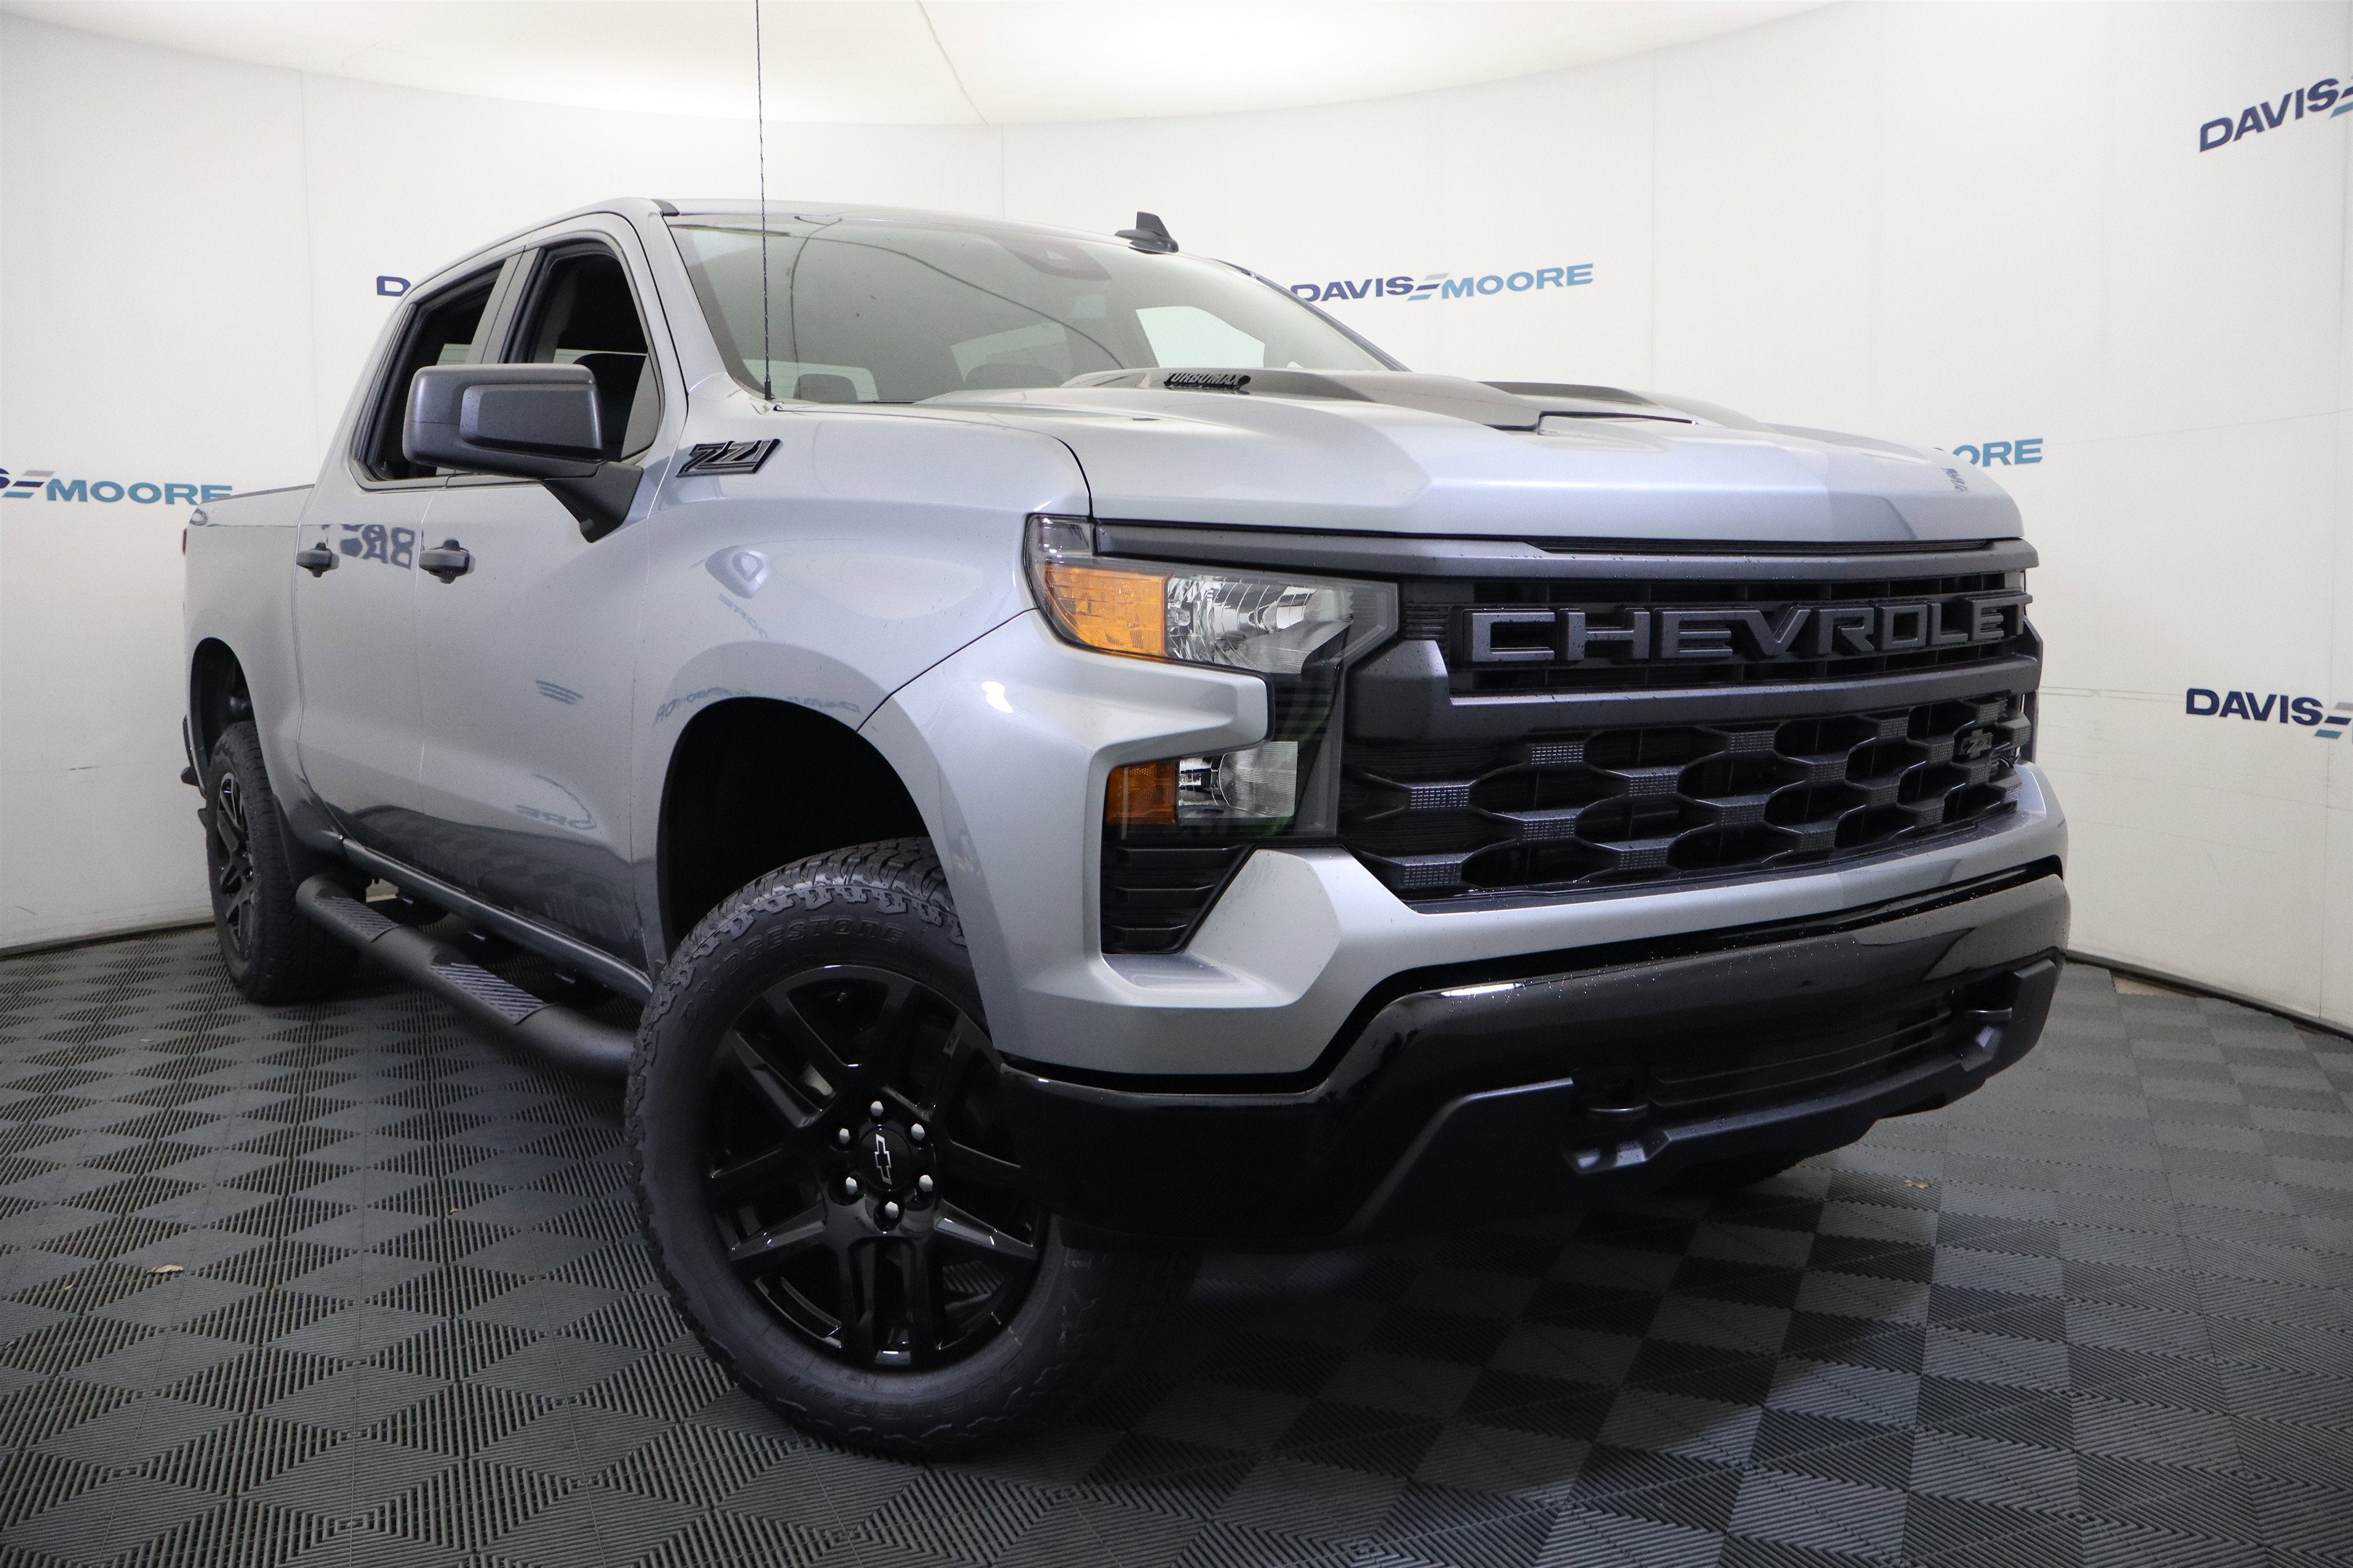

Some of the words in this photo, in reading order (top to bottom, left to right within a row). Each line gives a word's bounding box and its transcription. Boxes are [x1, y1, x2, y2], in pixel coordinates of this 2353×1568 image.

[2200, 78, 2339, 152] DAVIS
[1291, 276, 1415, 303] DAVIS
[1441, 263, 1594, 300] MOORE
[1165, 372, 1244, 388] TURBOMAX
[678, 438, 780, 477] Z71
[1934, 438, 2043, 467] ORE
[46, 478, 233, 505] MOORE
[1461, 593, 2032, 663] CHEVROLET
[2186, 688, 2324, 726] DAVIS
